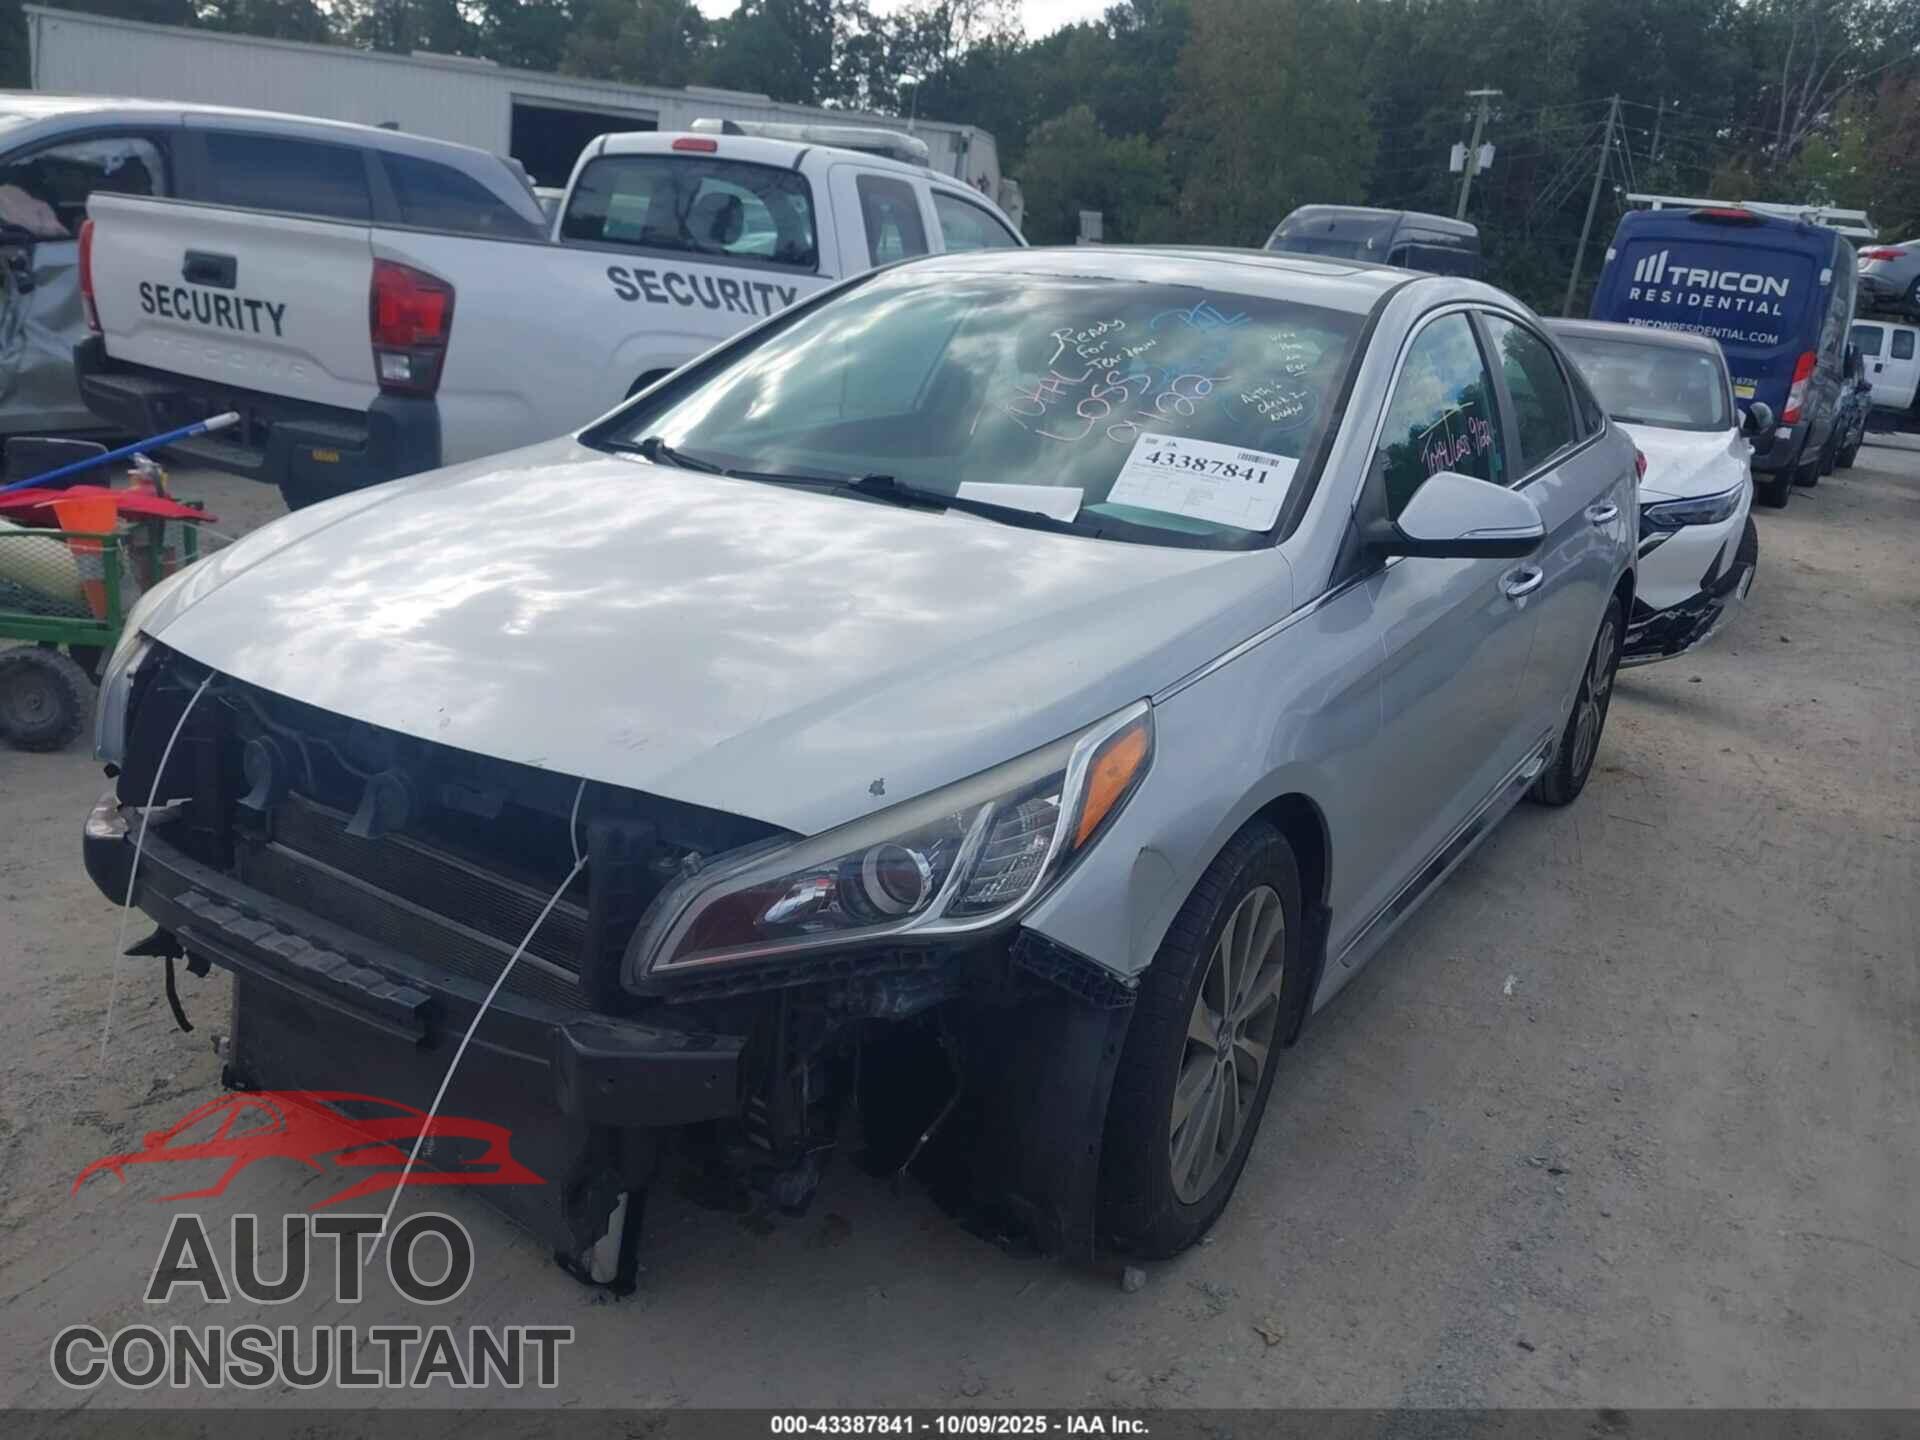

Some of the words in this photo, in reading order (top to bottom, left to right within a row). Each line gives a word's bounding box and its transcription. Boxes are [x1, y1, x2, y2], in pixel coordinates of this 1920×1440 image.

[606, 265, 797, 316] SECURITY
[1668, 266, 1791, 297] TRICON
[139, 281, 286, 337] SECURITY
[1629, 287, 1782, 316] RESIDENTIAL
[1627, 317, 1779, 345] TRICONRESIDENTIAL.COM
[1145, 450, 1269, 485] 43387841
